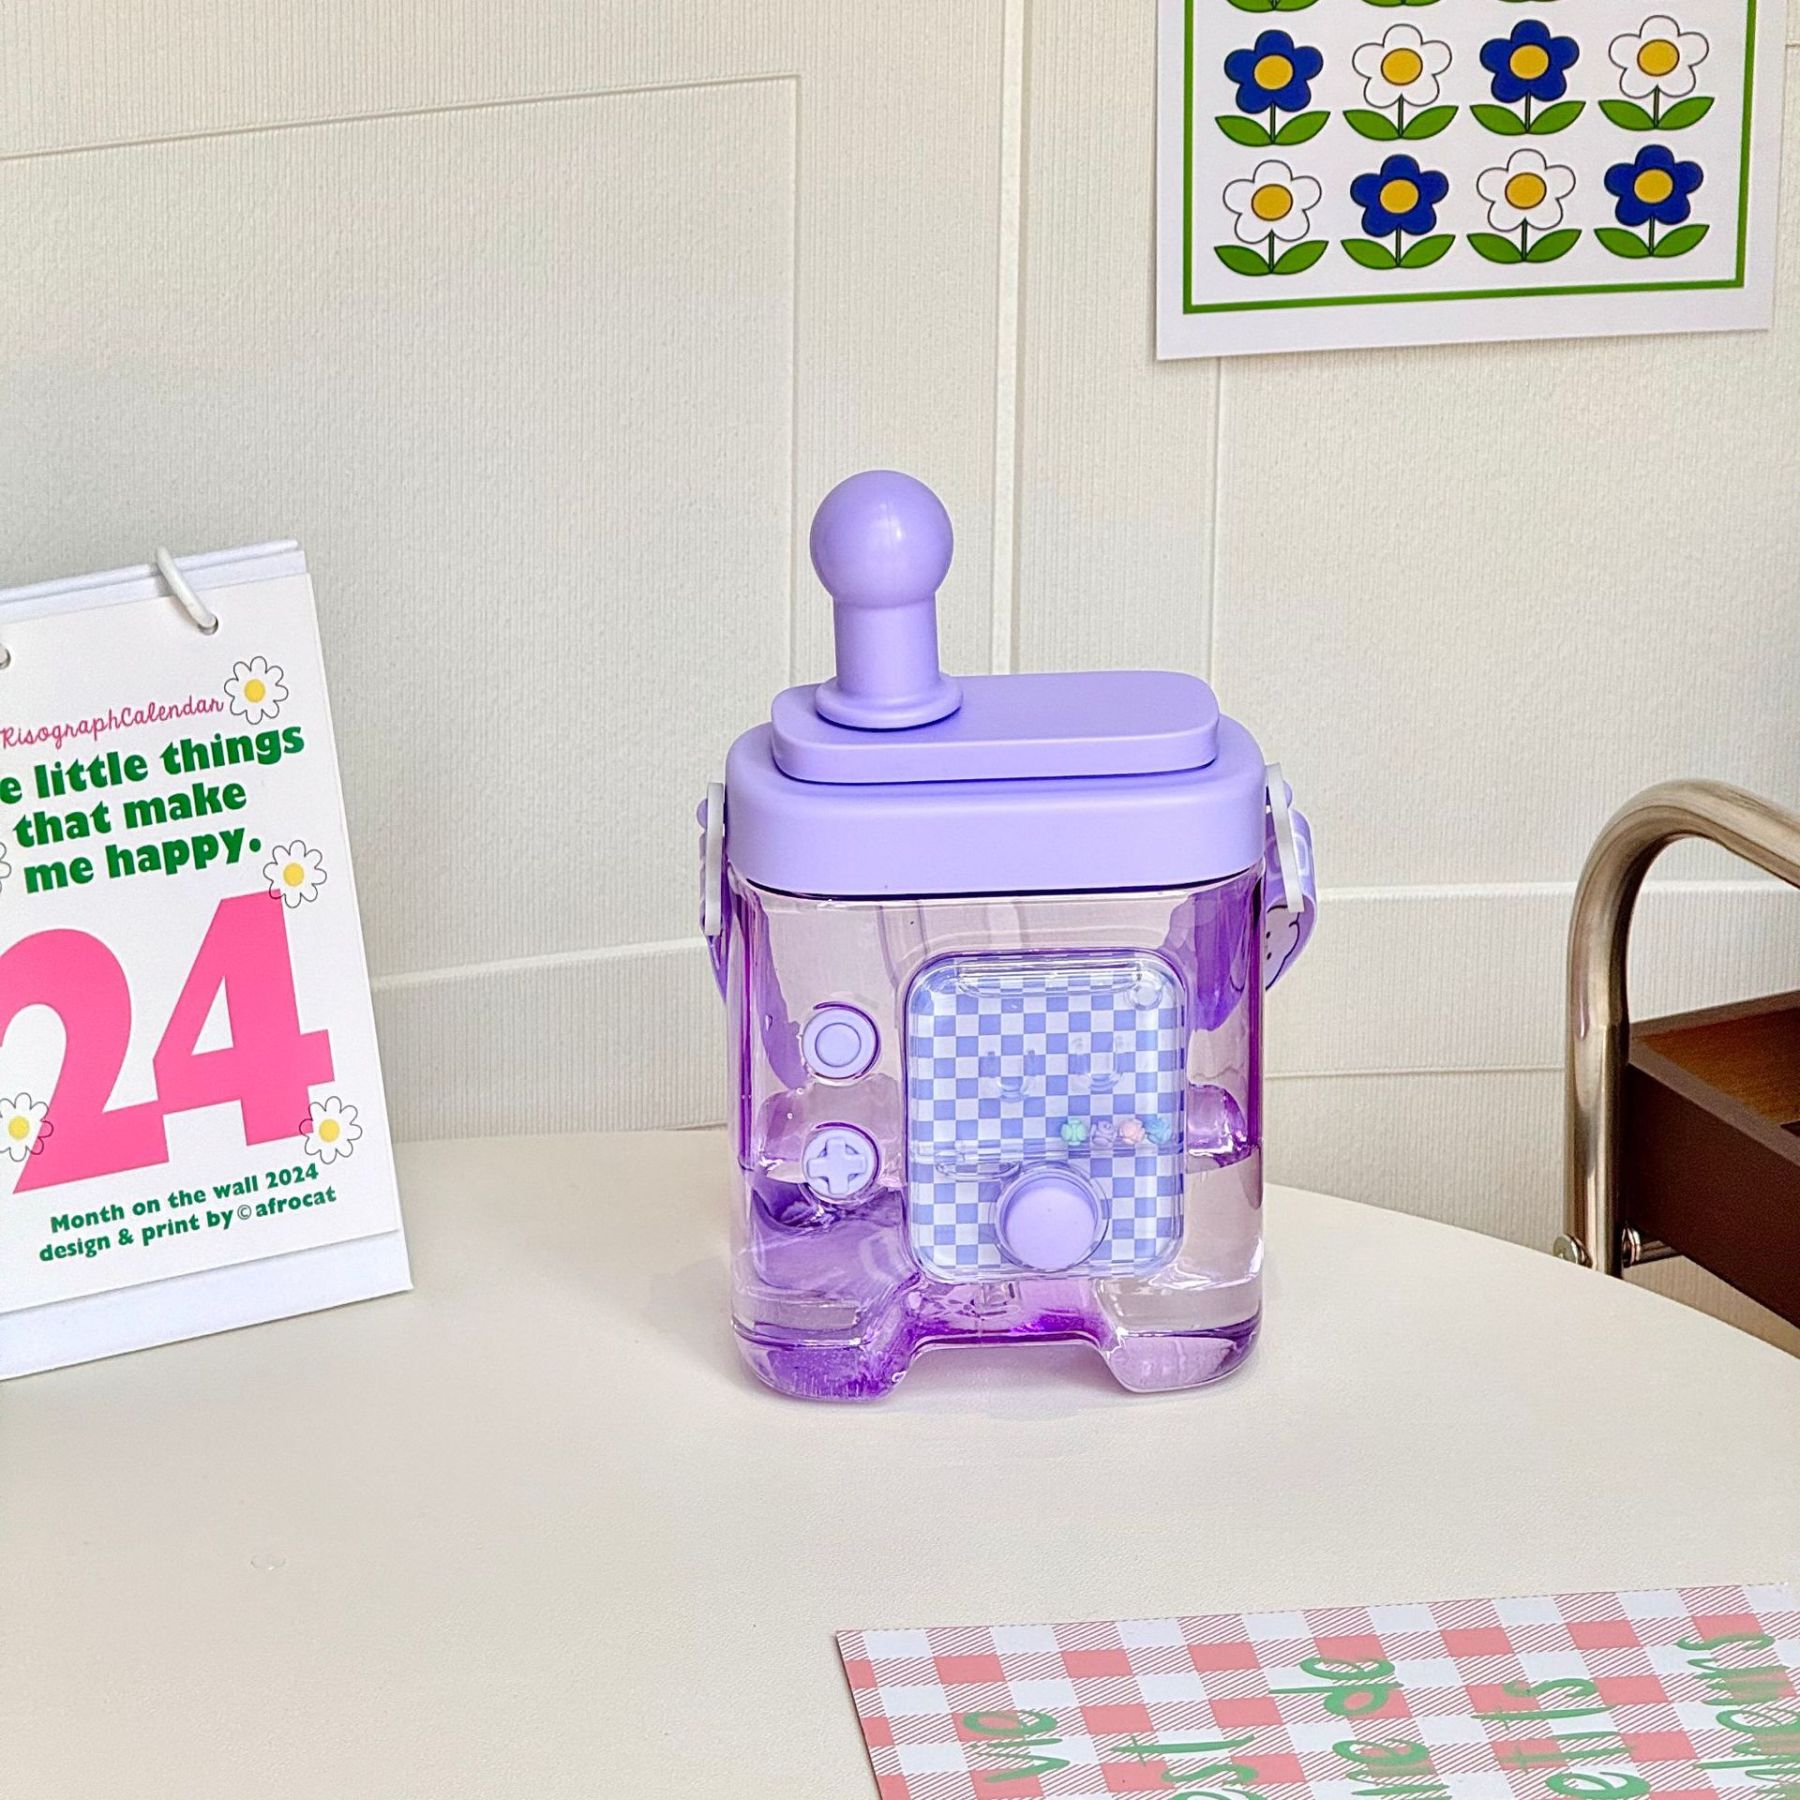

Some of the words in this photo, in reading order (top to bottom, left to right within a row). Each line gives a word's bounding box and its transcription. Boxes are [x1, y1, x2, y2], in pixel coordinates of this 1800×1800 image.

[34, 751, 149, 800] little
[160, 725, 305, 776] things
[13, 802, 113, 849] that
[123, 782, 247, 830] make
[24, 856, 94, 895] me
[105, 826, 262, 878] happy.
[0, 889, 334, 1194] 24
[50, 1204, 126, 1233] Month
[131, 1198, 162, 1217] on
[168, 1189, 207, 1210] the
[213, 1175, 260, 1200] wall
[266, 1162, 320, 1189] 2024
[39, 1221, 112, 1262] design
[118, 1227, 135, 1247] &
[141, 1215, 200, 1247] print
[1269, 1655, 1404, 1717] de
